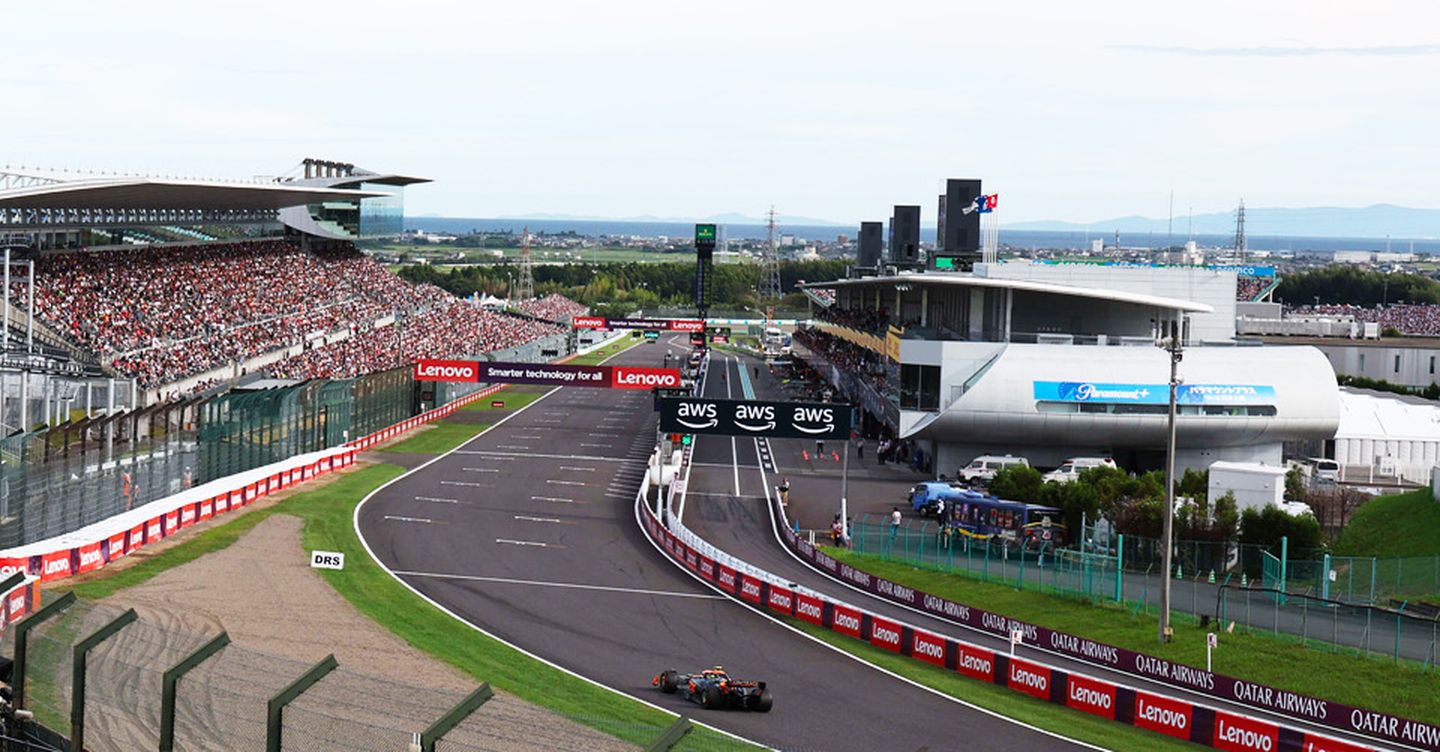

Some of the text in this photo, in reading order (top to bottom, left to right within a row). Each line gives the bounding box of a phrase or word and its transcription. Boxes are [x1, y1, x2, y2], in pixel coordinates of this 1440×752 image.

[574, 318, 602, 327] Lenovo
[673, 321, 702, 330] Lenovo
[418, 365, 473, 378] Lenovo
[488, 367, 603, 381] Smarter technology for all
[617, 371, 675, 386] Lenovo
[677, 402, 717, 418] aws
[735, 404, 775, 421] aws
[793, 407, 834, 424] aws
[44, 557, 70, 574] Lenovo
[314, 554, 340, 567] DRS
[769, 588, 791, 608] Lenovo
[797, 598, 821, 618] Lenovo
[923, 594, 970, 621] QATAR AIRWAYS
[834, 610, 859, 631] Lenovo
[982, 612, 1006, 631] QATAR
[872, 623, 900, 645] Lenovo
[914, 635, 943, 659] Lenovo
[1050, 632, 1119, 664] QATAR AIRWAYS
[960, 649, 991, 674] Lenovo
[1011, 664, 1047, 691] Lenovo
[1136, 654, 1215, 690] QATAR AIRWAYS
[1070, 681, 1111, 710] Lenovo
[1233, 680, 1327, 720] QATAR AIRWAYS
[1138, 699, 1187, 730] Lenovo
[1351, 709, 1398, 738] QATAR
[1218, 719, 1272, 752] Lenovo
